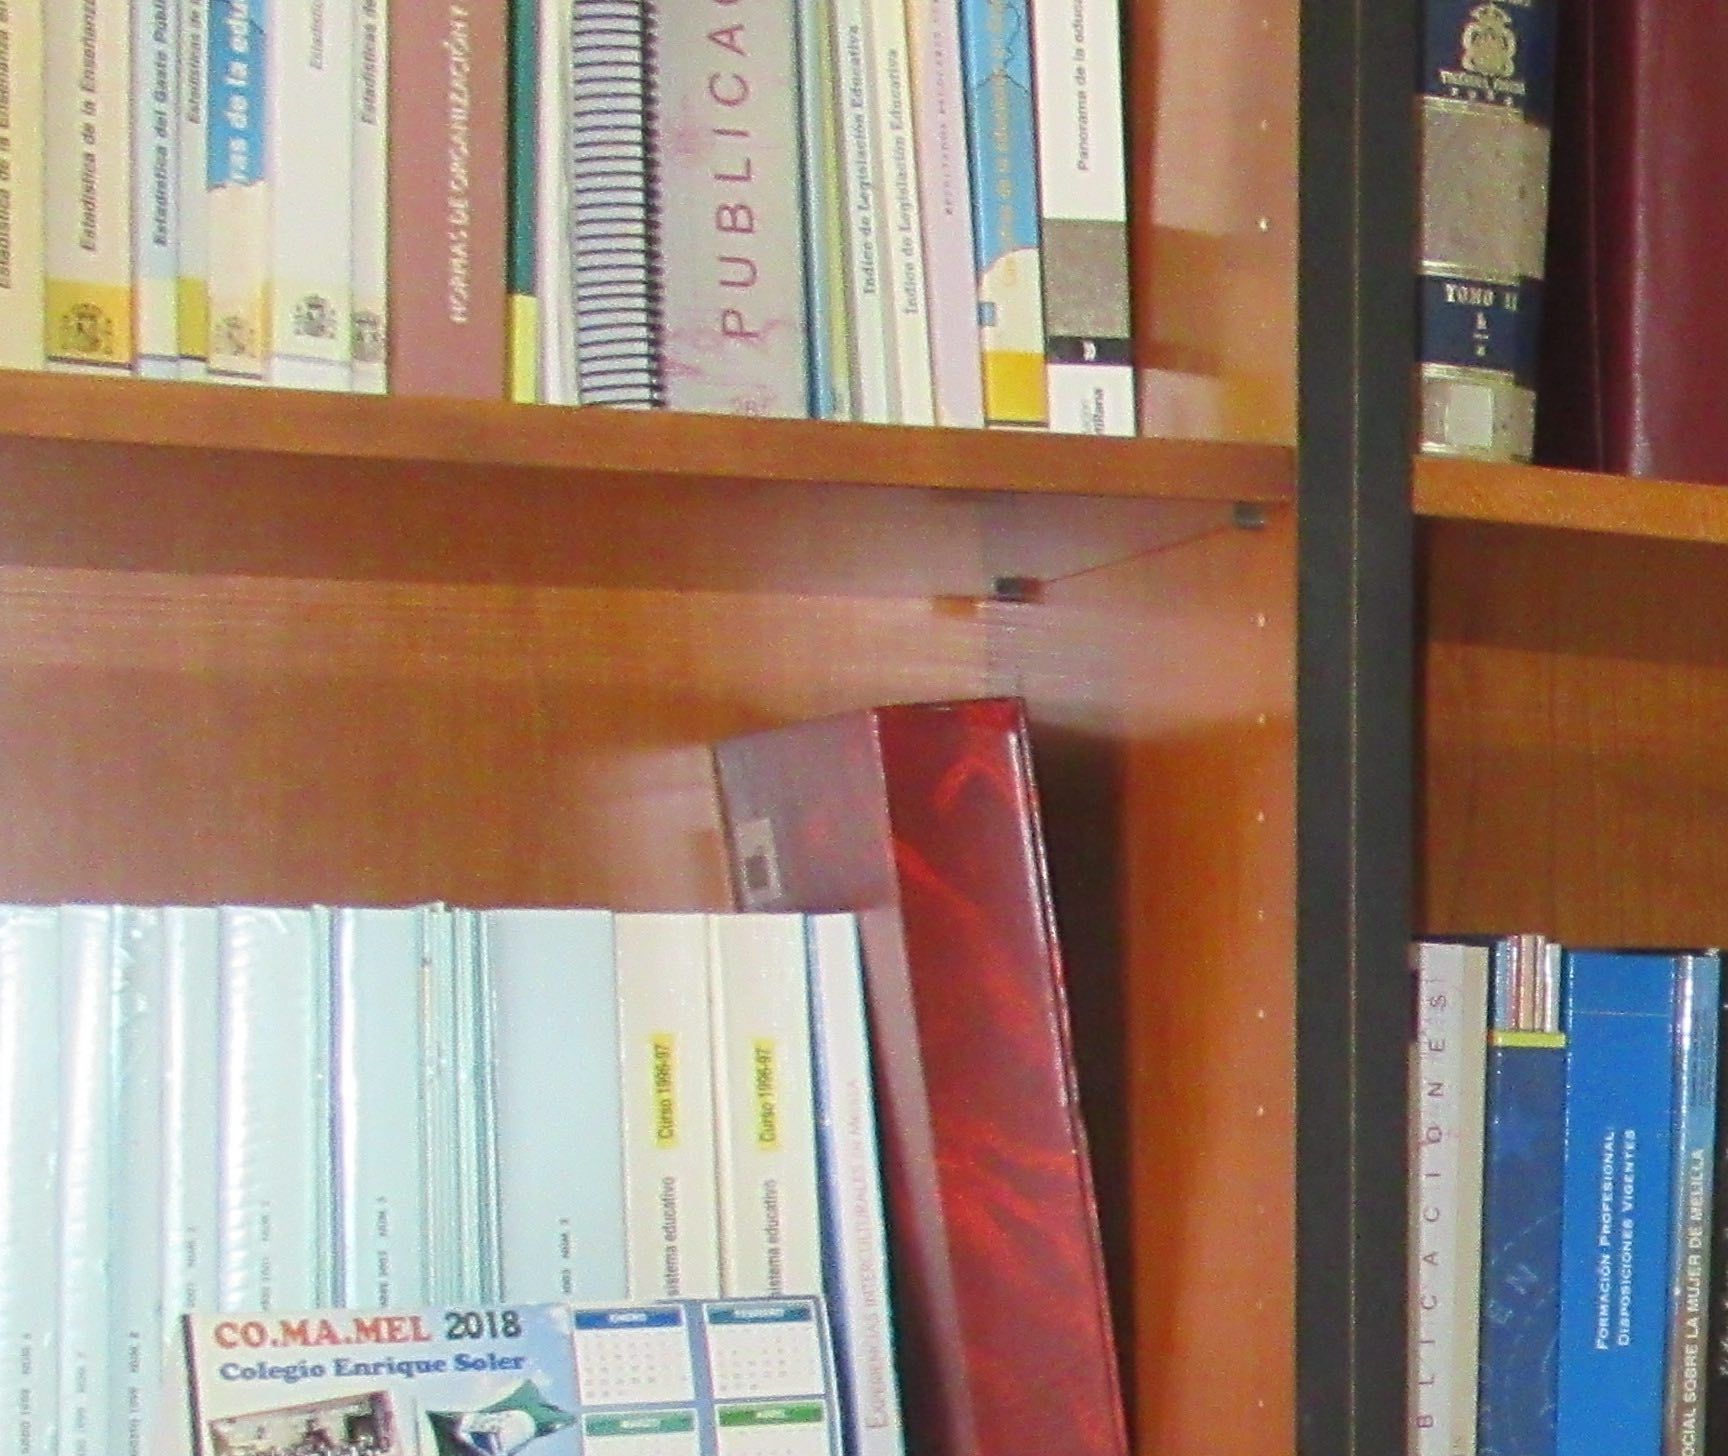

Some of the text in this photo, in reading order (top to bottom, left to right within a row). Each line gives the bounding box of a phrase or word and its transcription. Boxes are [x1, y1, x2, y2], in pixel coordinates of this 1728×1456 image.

[1071, 45, 1092, 172] Panorama de la
[705, 0, 762, 340] PUBLICA
[656, 1099, 676, 1141] Curso
[756, 1103, 776, 1143] Curso
[660, 1176, 678, 1242] educativo
[761, 1178, 780, 1244] educativo
[1690, 1147, 1707, 1218] MELILLA
[1617, 1128, 1637, 1347] DISPOSICIONES VIGENTES
[1690, 1223, 1704, 1247] DE
[1686, 1252, 1703, 1311] MUJER
[213, 1310, 523, 1349] CO.MA.MEL 2018
[1686, 1316, 1701, 1336] LA
[219, 1352, 526, 1383] Colegio Enrique Soler
[1683, 1339, 1700, 1401] SOBRE
